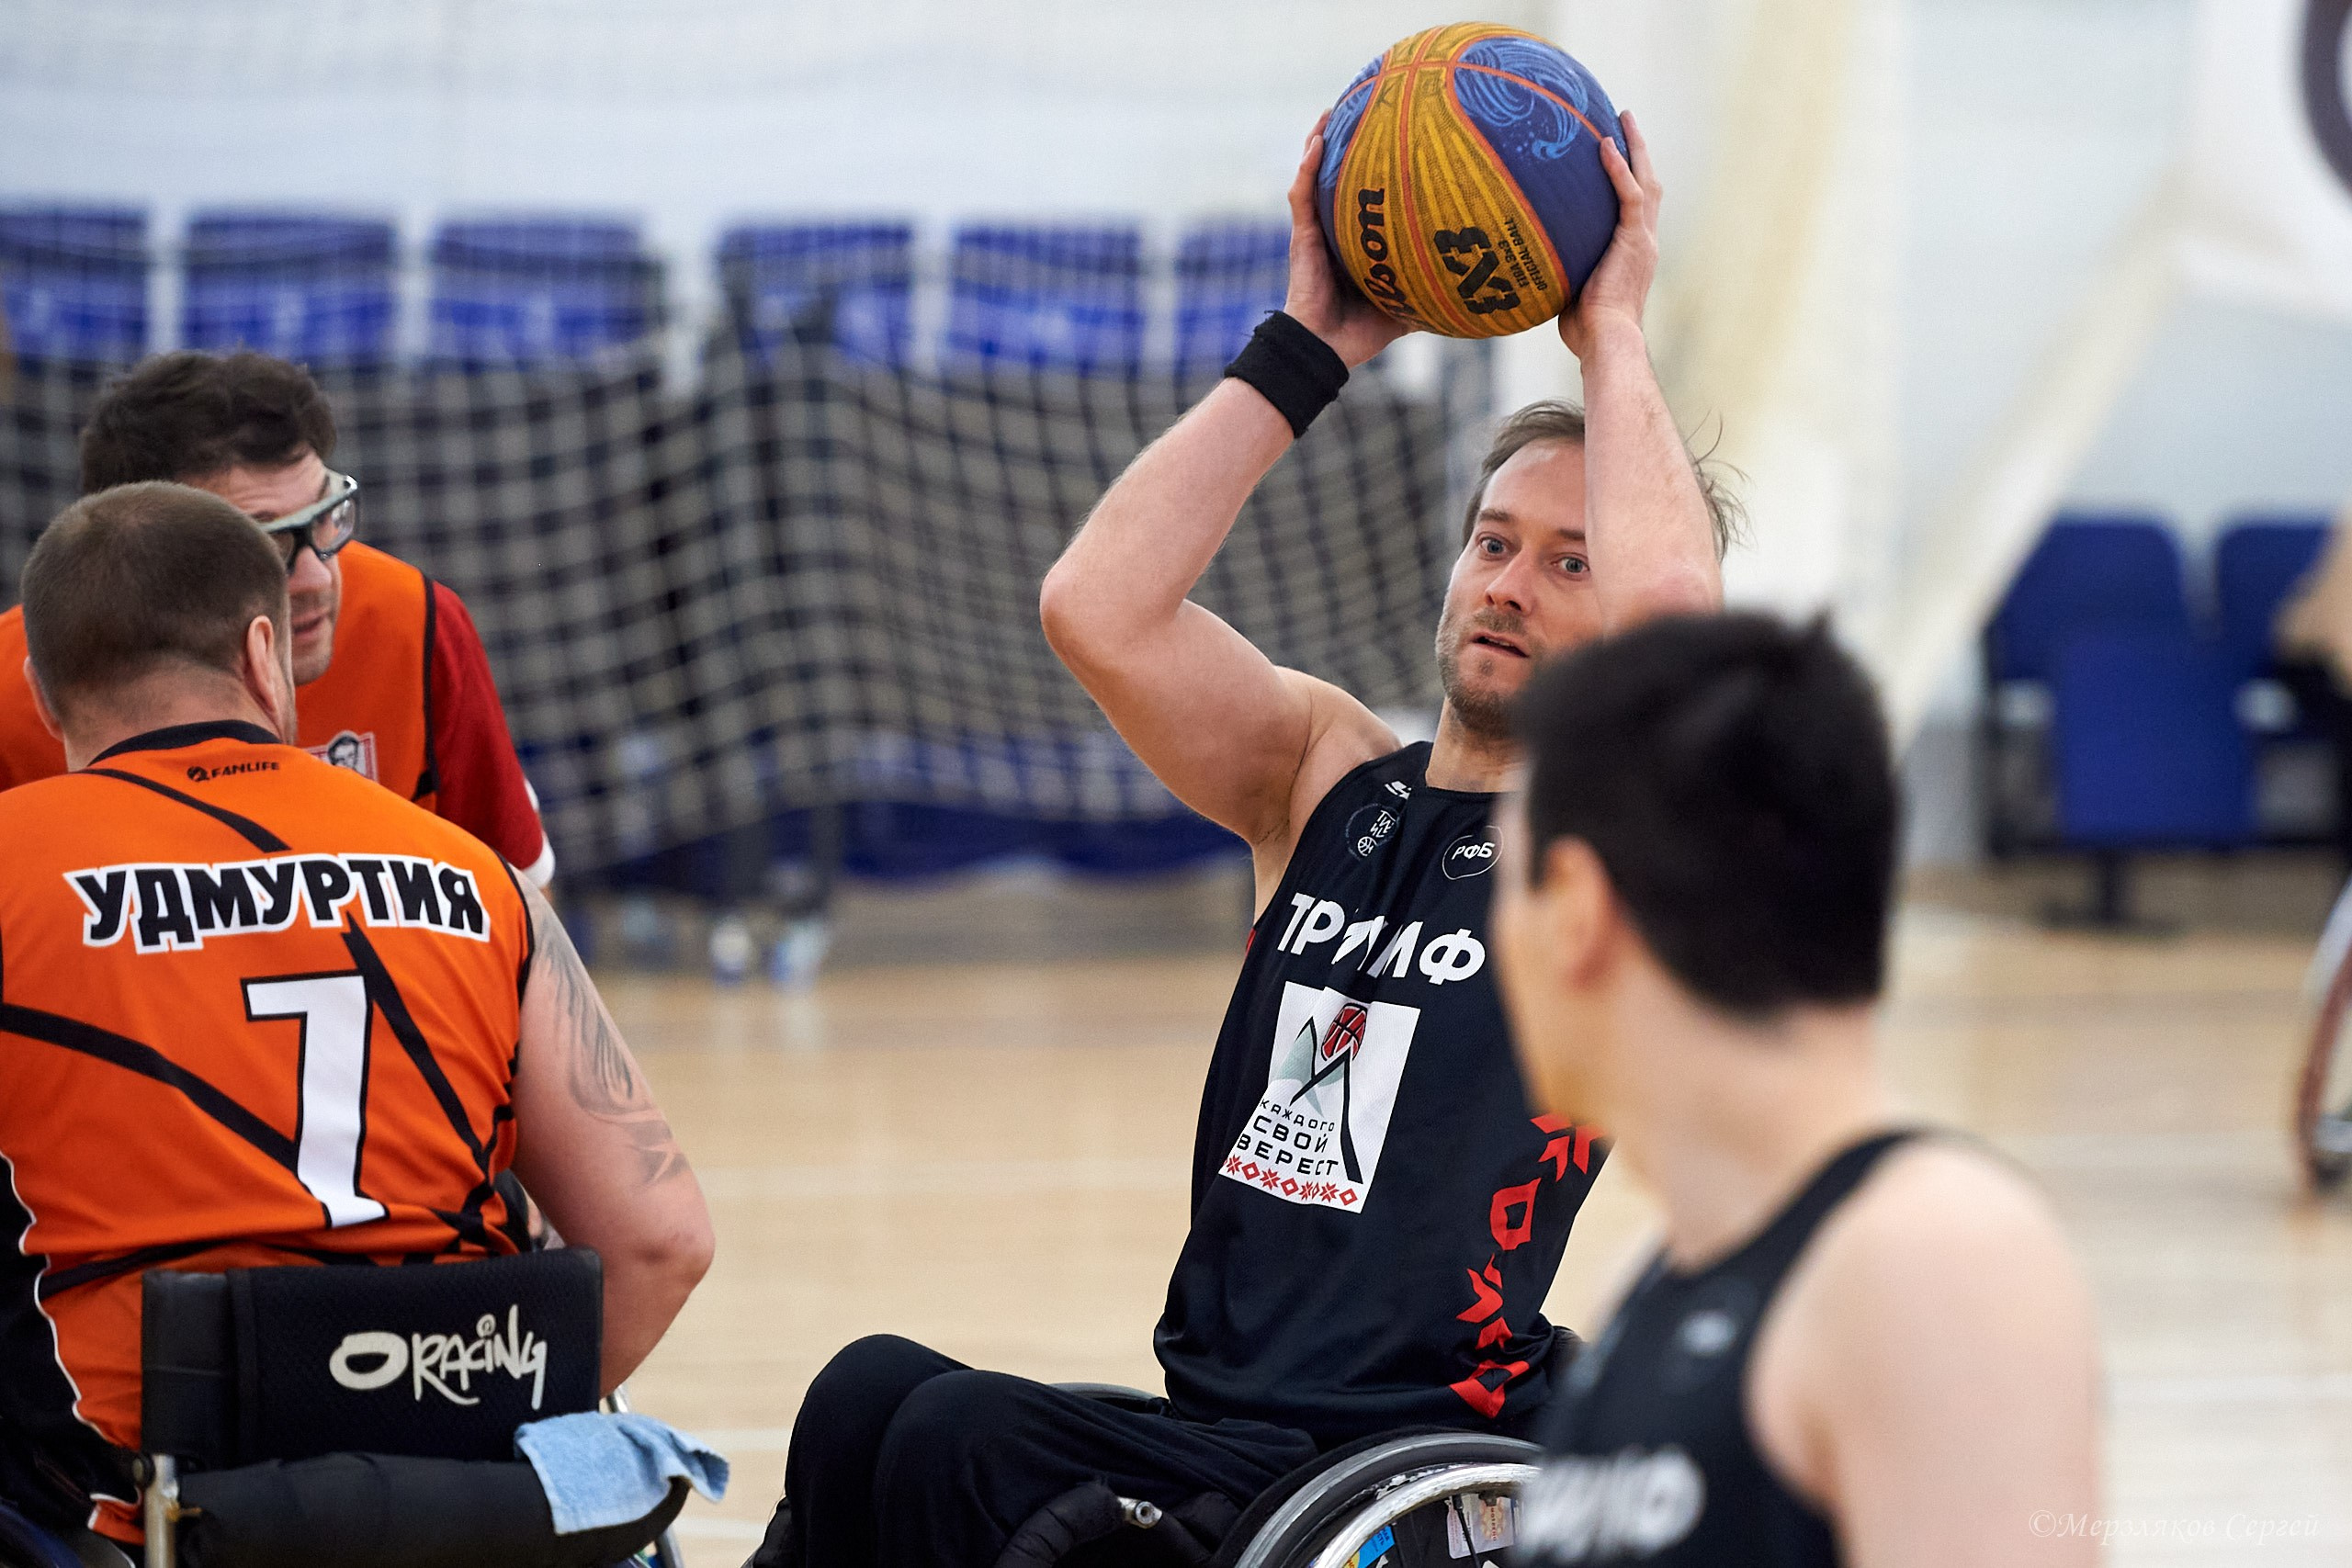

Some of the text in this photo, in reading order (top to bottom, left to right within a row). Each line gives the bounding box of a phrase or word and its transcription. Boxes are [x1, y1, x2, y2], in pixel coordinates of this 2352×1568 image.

[1357, 187, 1433, 333] ilson
[1504, 217, 1548, 291] OFFICIAL BALL
[211, 761, 279, 779] FANLIFE
[1451, 841, 1496, 860] РФБ
[63, 852, 490, 954] УДМУРТИЯ
[1253, 1114, 1329, 1153] СВОЙ
[1260, 1099, 1335, 1132] КАЖДОГО
